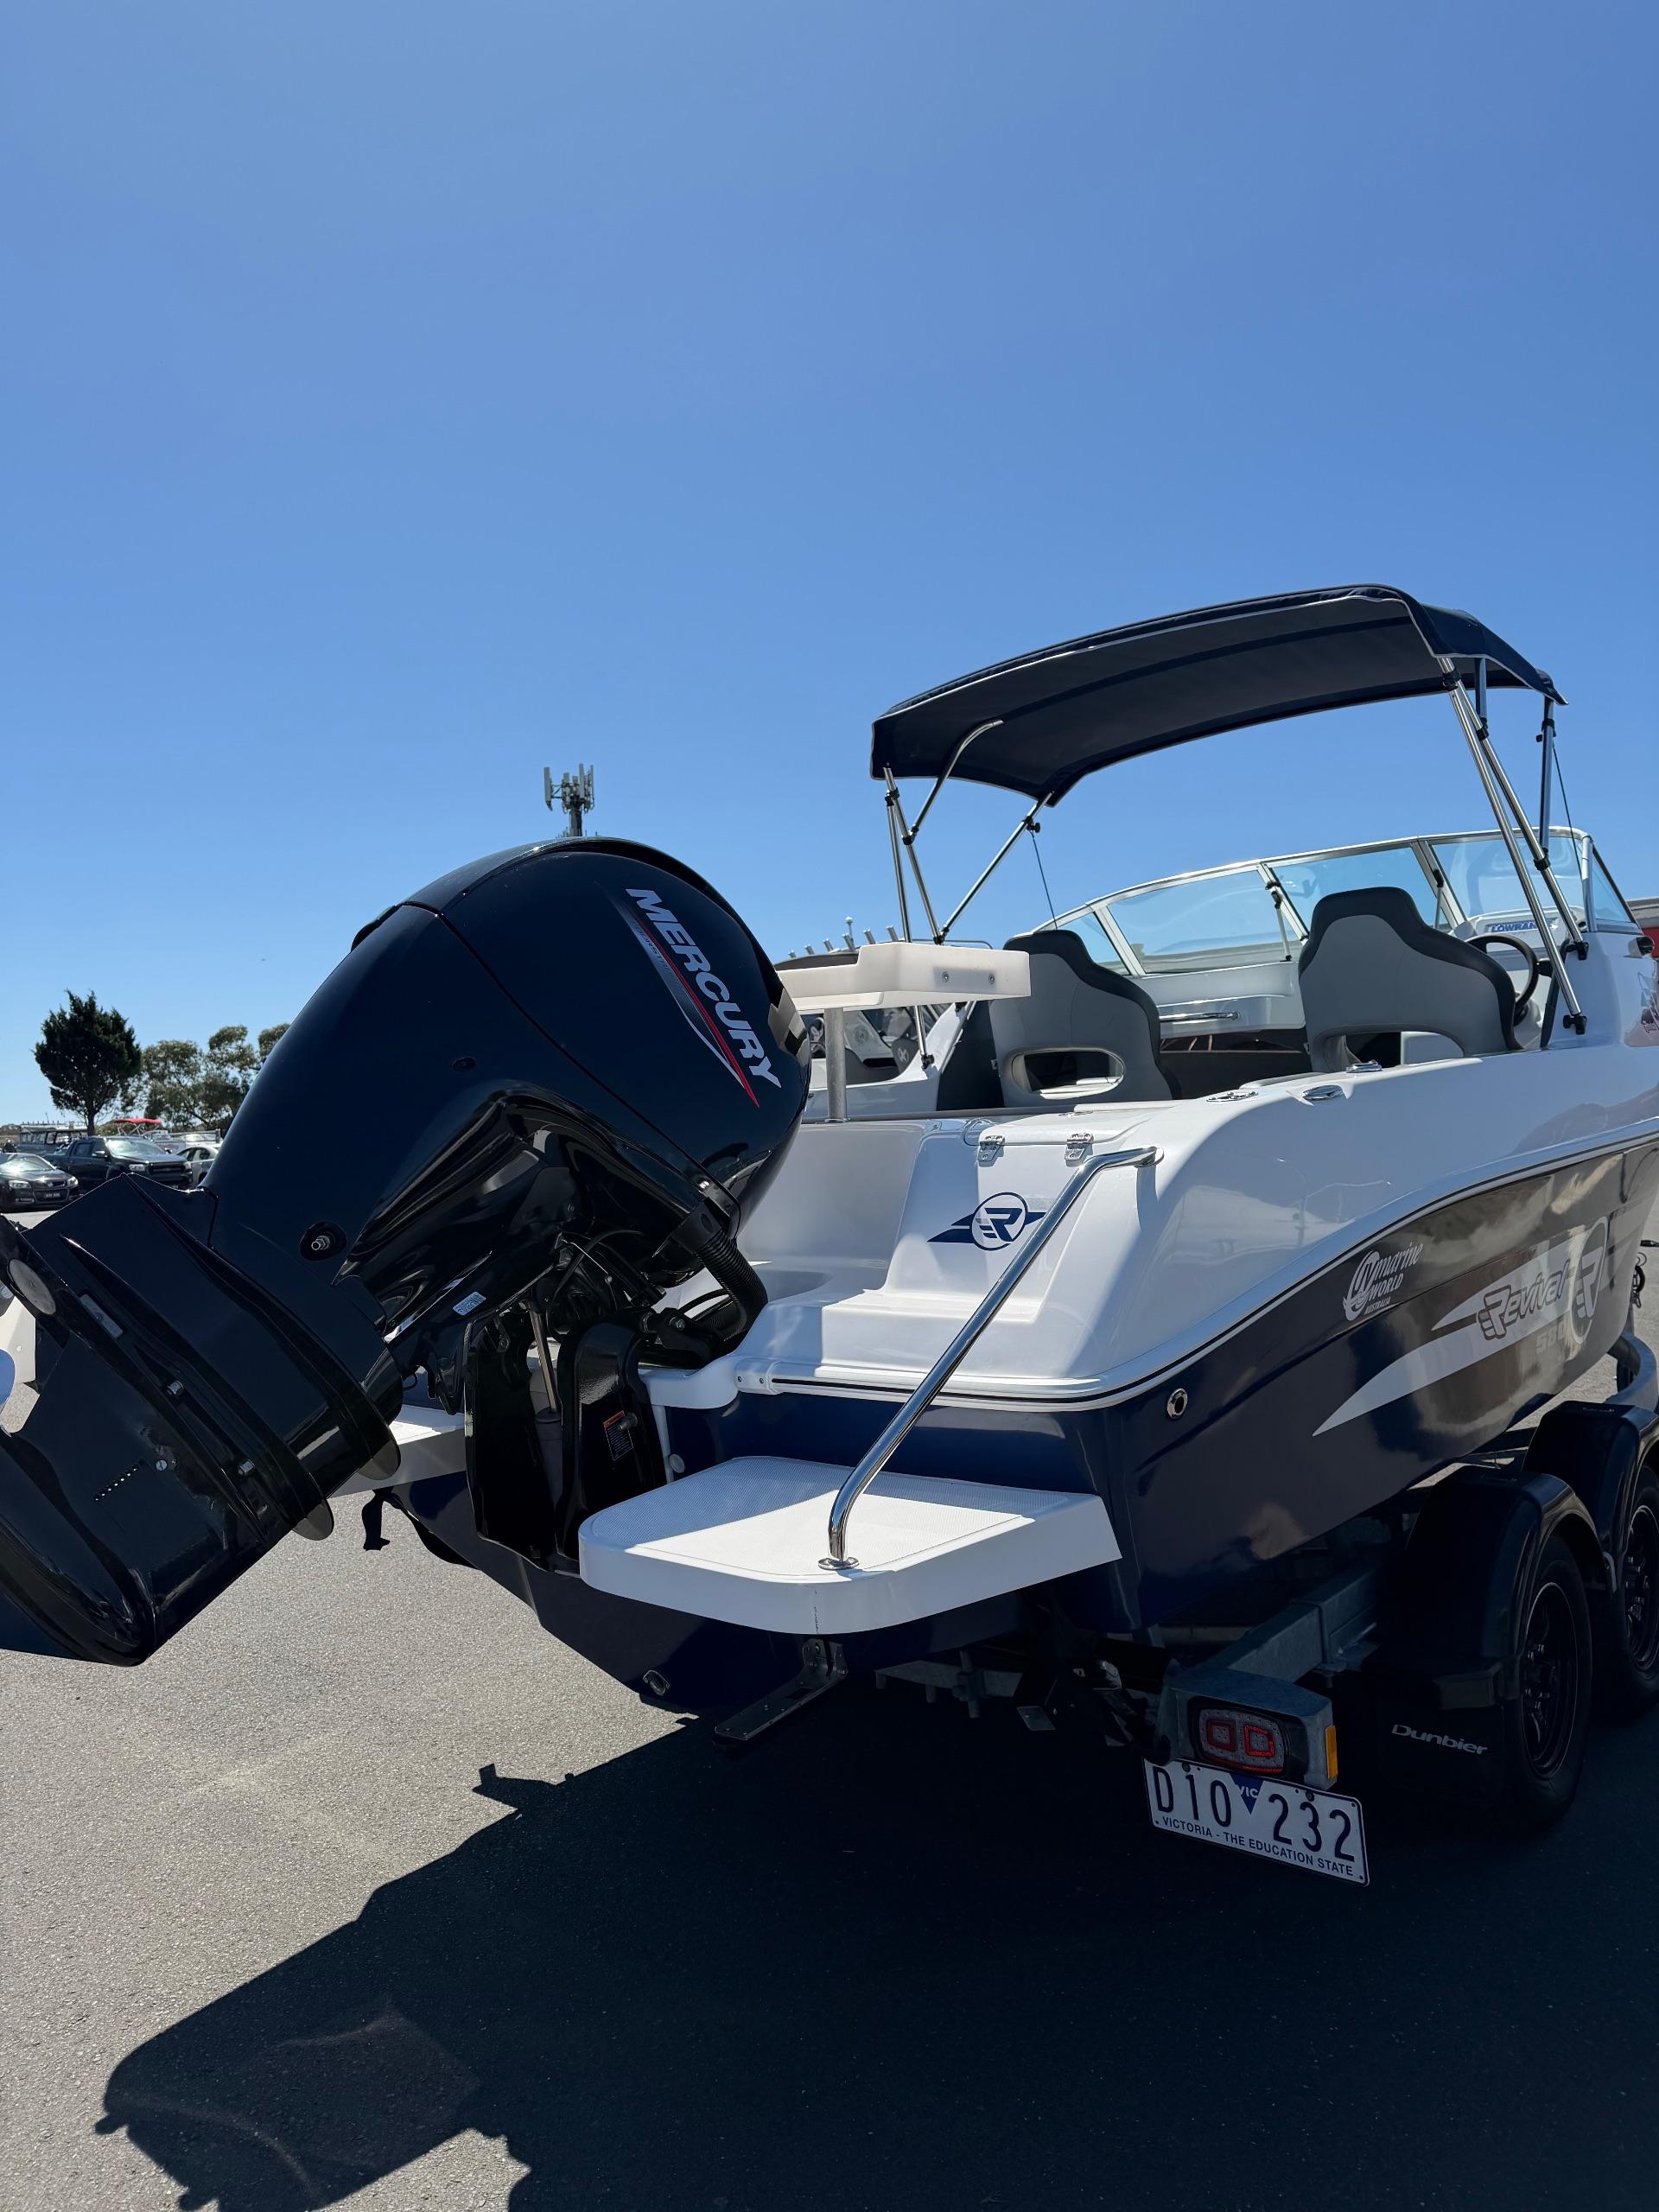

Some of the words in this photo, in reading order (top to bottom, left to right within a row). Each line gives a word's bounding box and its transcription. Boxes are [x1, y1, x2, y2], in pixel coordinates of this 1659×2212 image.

[1491, 921, 1536, 933] LOWRAN
[625, 888, 782, 1089] MERCURY
[1368, 1273, 1404, 1301] WORLD
[1478, 1258, 1572, 1341] Revival
[1363, 1296, 1391, 1315] AUSTRALIA
[1391, 1724, 1488, 1755] Dunbier
[1237, 1785, 1259, 1797] VIC
[1153, 1765, 1232, 1827] D10
[1268, 1793, 1356, 1862] 232
[1162, 1816, 1213, 1838] VICTORIA
[1223, 1832, 1245, 1847] THE
[1249, 1838, 1313, 1866] EDUCATION
[1317, 1858, 1353, 1877] STATE
